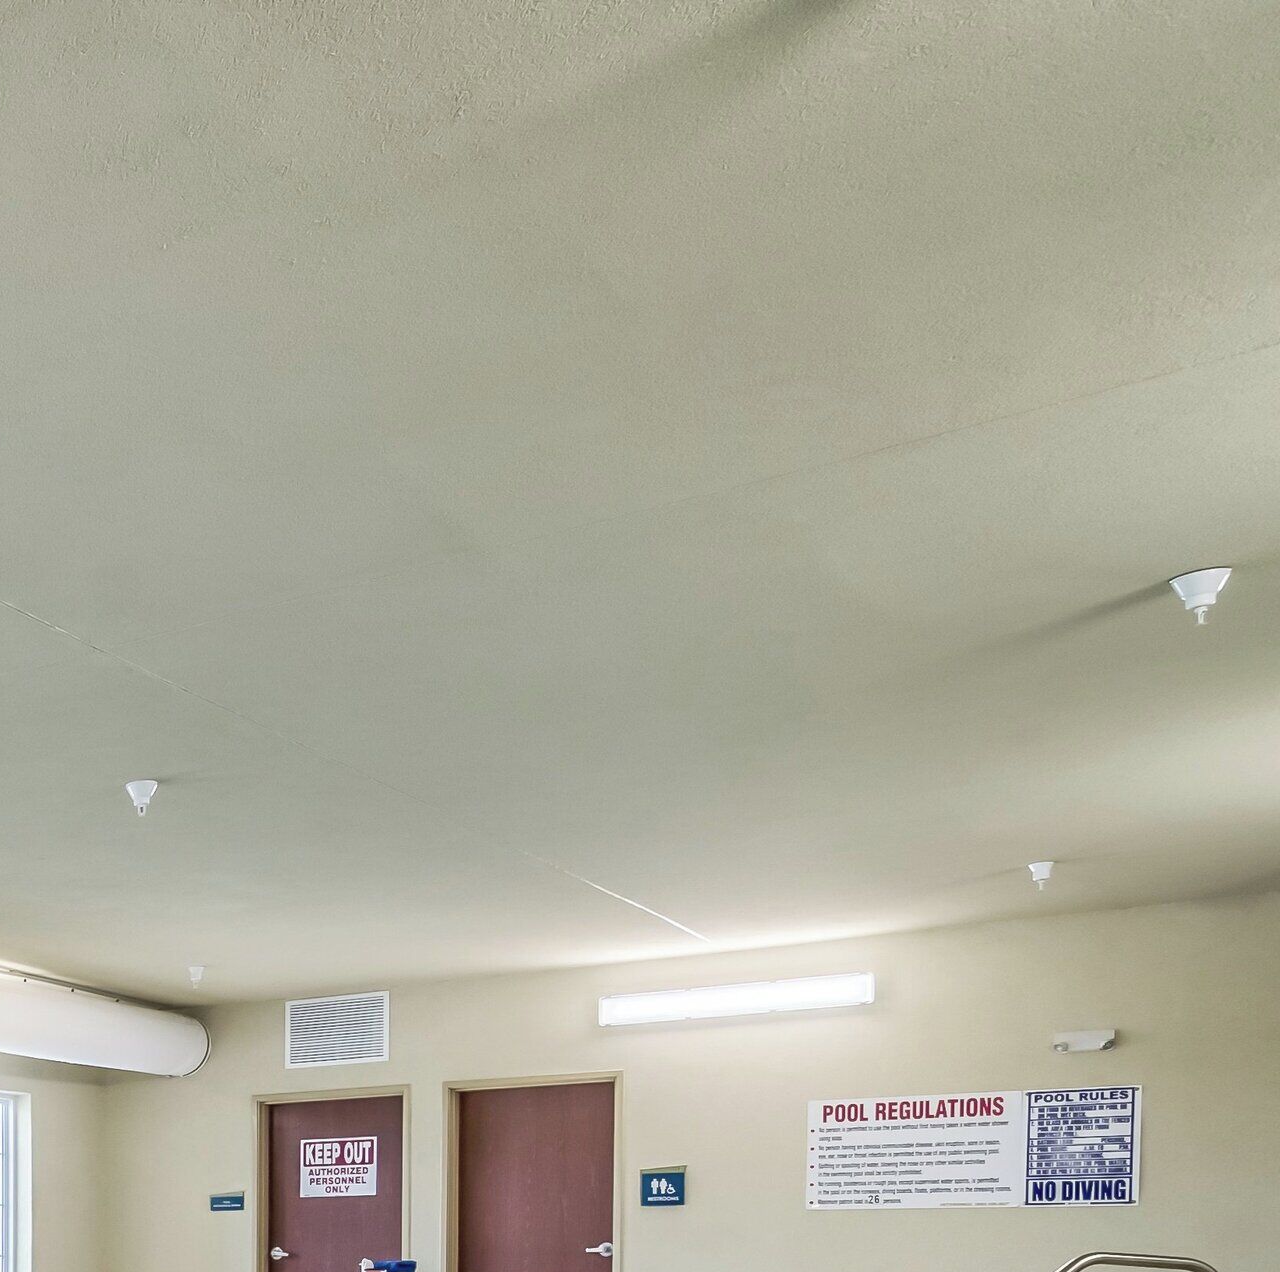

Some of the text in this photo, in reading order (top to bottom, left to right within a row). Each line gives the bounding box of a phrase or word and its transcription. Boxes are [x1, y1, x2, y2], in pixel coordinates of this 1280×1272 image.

[1034, 1090, 1129, 1103] POOL RULES
[822, 1104, 869, 1123] POOL
[875, 1096, 1005, 1121] REGULATIONS
[305, 1141, 372, 1165] KEEP OUT
[308, 1167, 369, 1176] AUTHORIZED
[309, 1176, 367, 1185] PERSONNEL
[325, 1185, 350, 1194] ONLY
[1032, 1180, 1126, 1201] NO DIVING
[868, 1195, 880, 1204] 26
